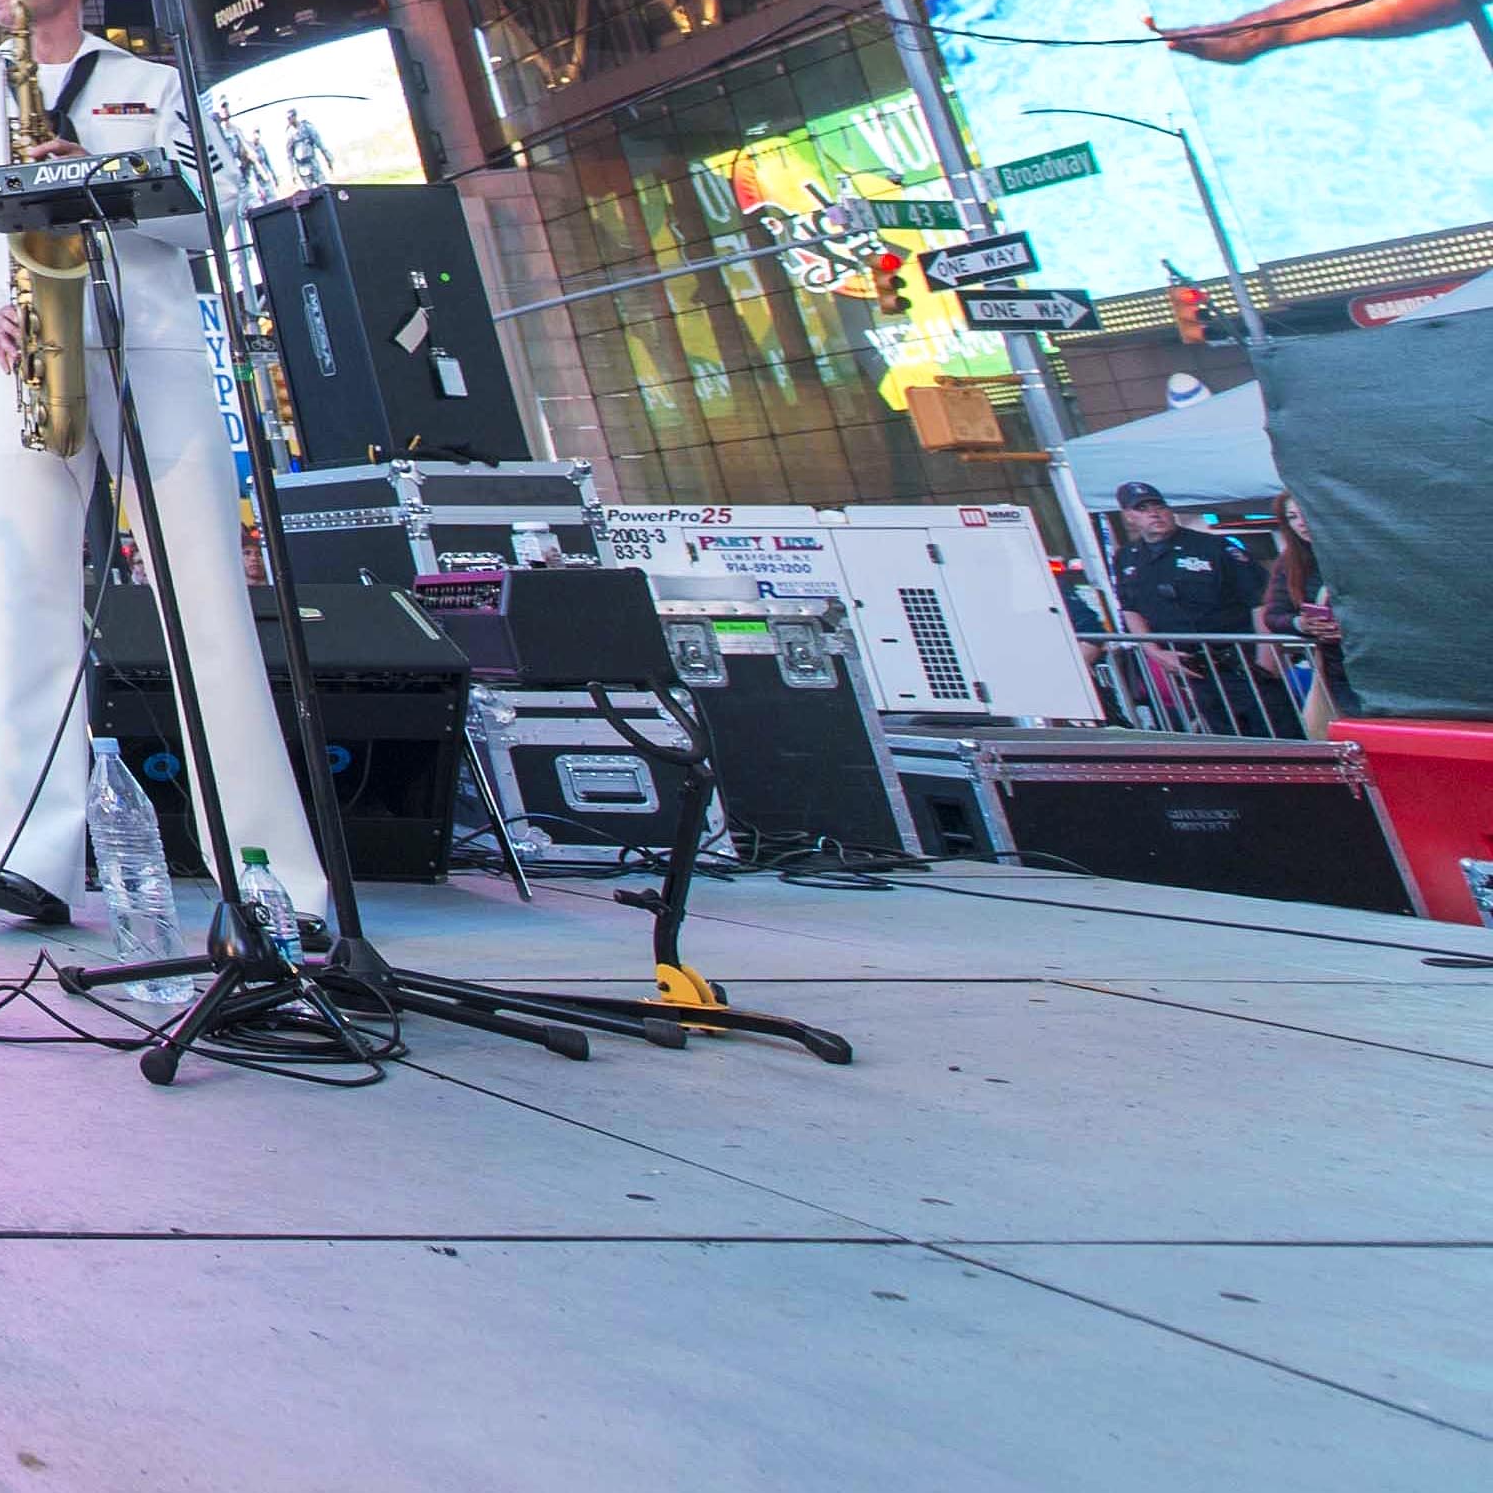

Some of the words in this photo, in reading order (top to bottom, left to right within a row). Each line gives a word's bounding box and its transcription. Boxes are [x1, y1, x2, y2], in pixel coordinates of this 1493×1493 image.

[1001, 150, 1093, 190] Broadway
[876, 203, 898, 228] W
[909, 203, 935, 228] 43
[936, 257, 969, 278] ONE
[980, 245, 1019, 265] WAY
[979, 302, 1023, 318] ONE
[1034, 302, 1075, 319] WAY
[198, 299, 245, 445] NYPD
[610, 527, 667, 544] 2003-3
[614, 544, 653, 560] 83-3
